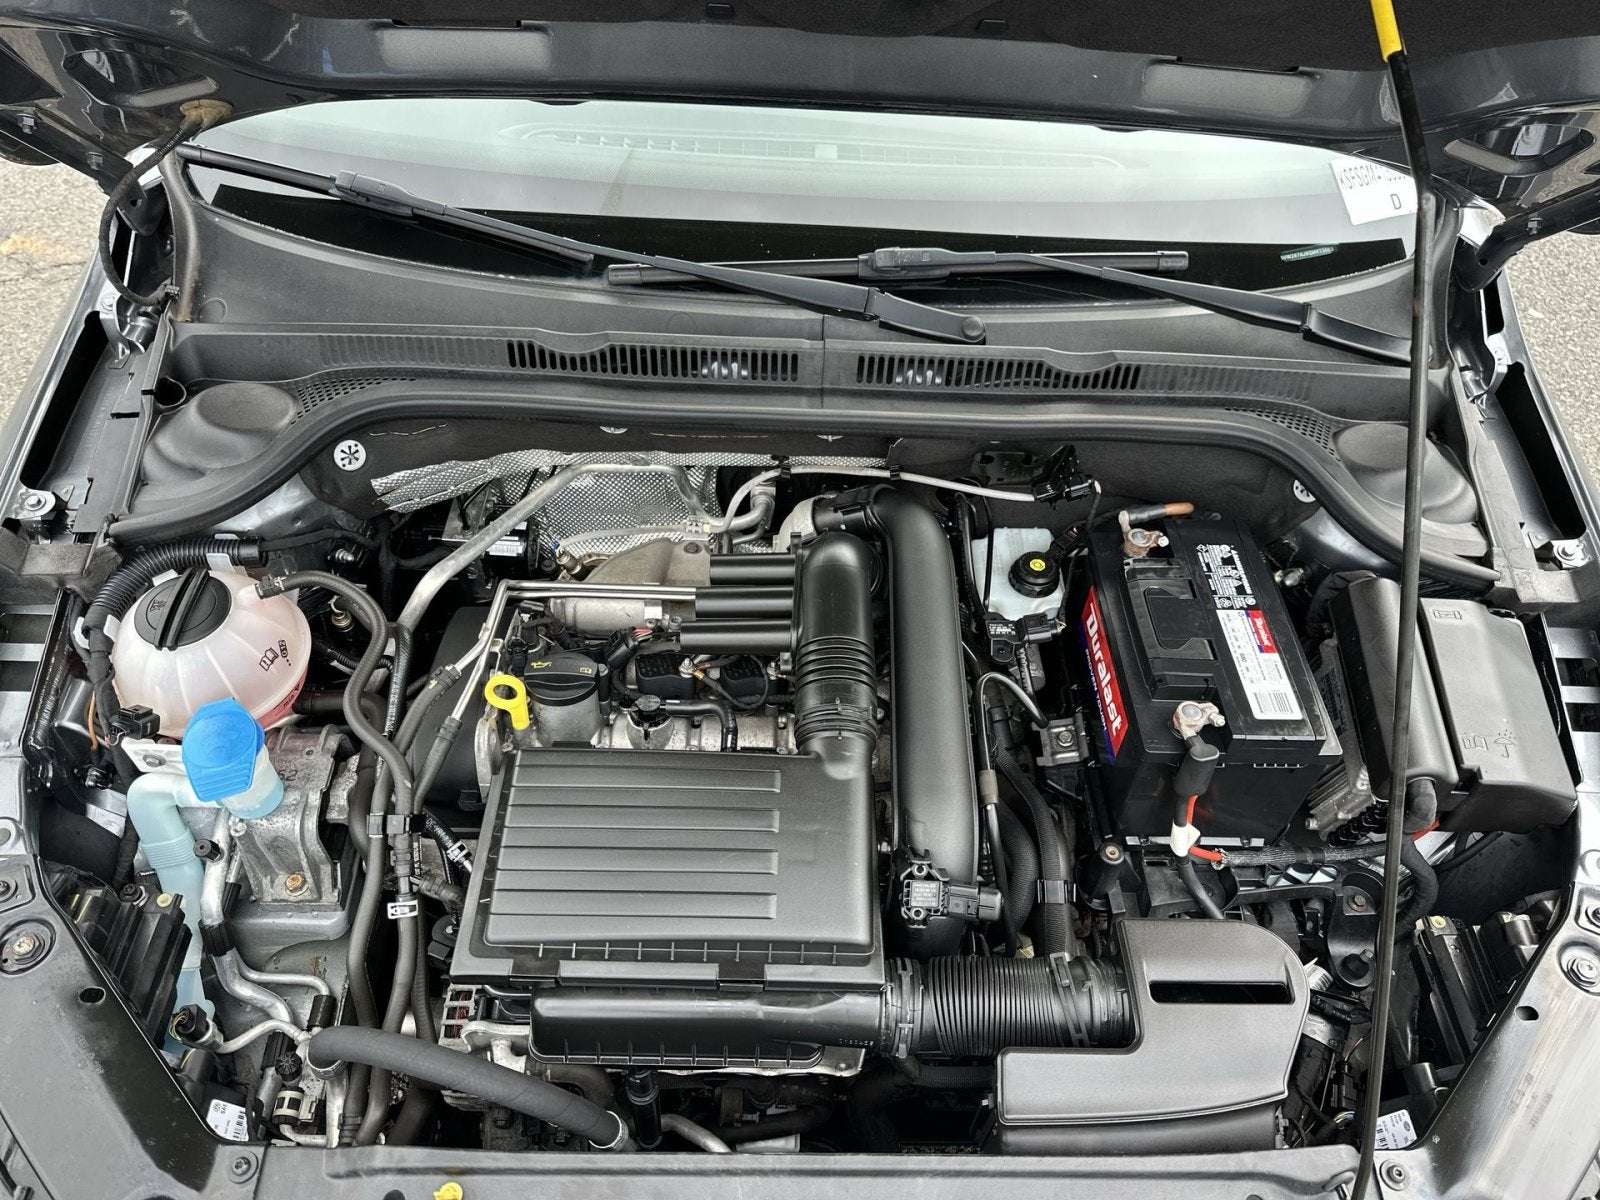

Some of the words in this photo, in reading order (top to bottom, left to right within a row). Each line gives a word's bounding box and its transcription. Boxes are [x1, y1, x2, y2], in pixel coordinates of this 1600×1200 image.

[1390, 193, 1402, 210] D
[1085, 648, 1098, 691] PROVEN
[1086, 602, 1122, 736] Duralast
